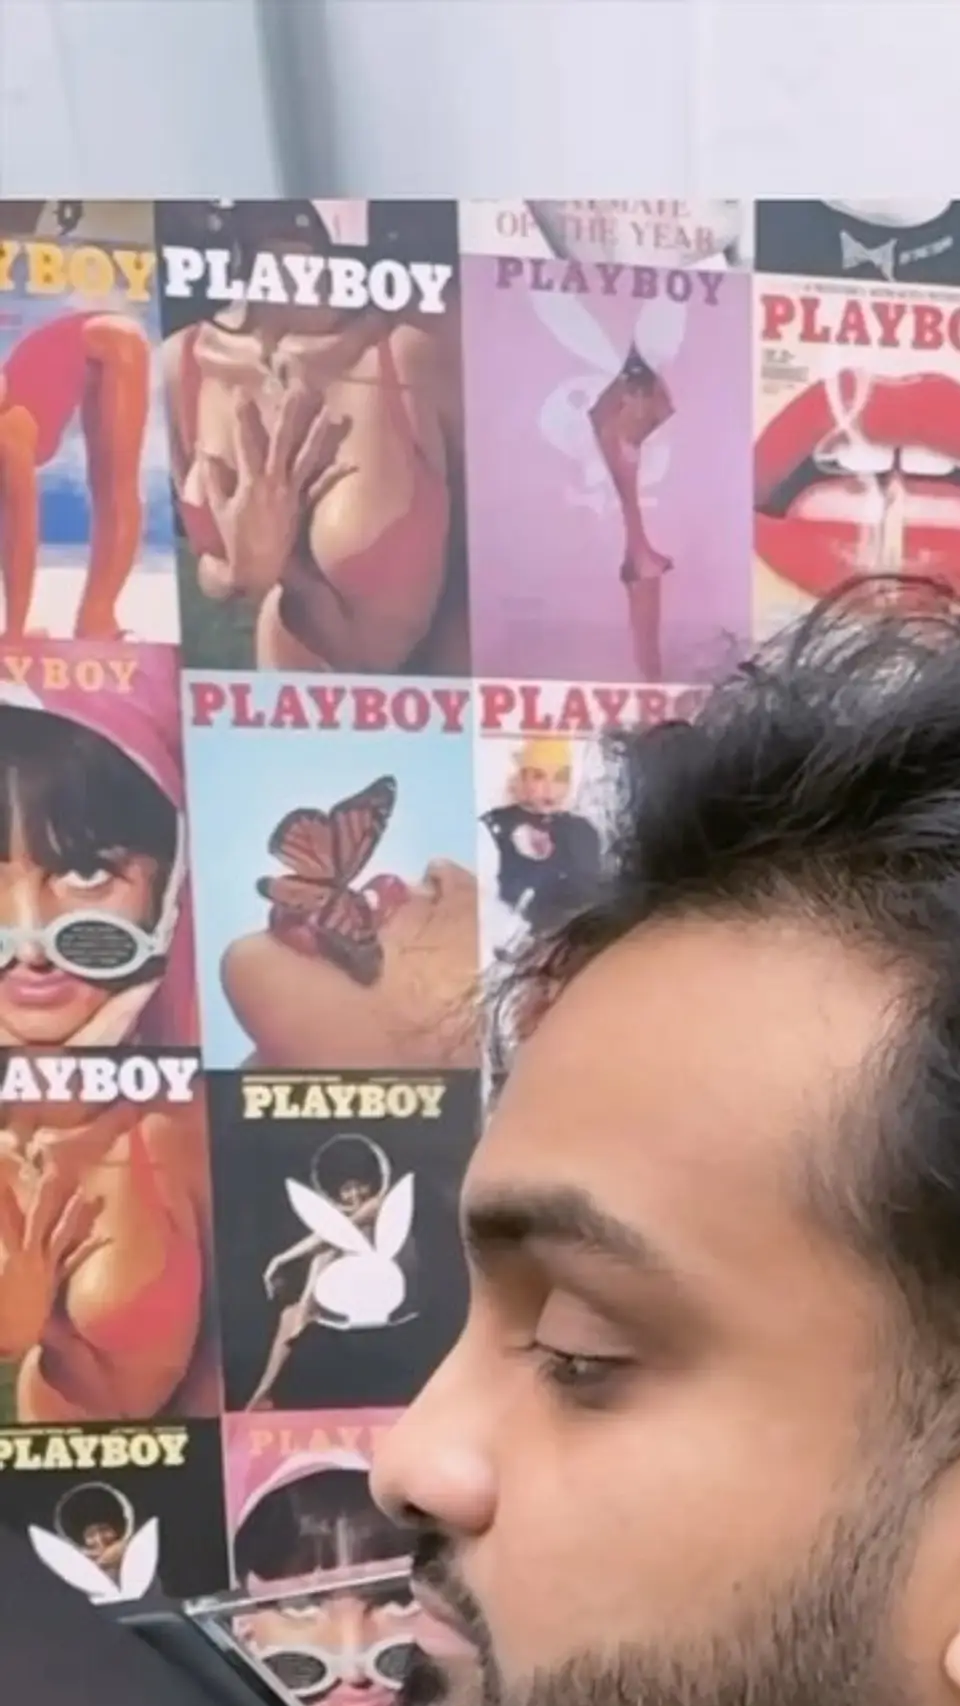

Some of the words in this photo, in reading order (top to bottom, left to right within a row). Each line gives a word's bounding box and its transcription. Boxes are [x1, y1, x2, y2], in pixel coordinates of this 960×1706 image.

[162, 246, 452, 313] PLAYBOY
[495, 256, 724, 306] PLAYBOY
[189, 681, 471, 735] PLAYBOY
[242, 1083, 446, 1119] PLAYBOY
